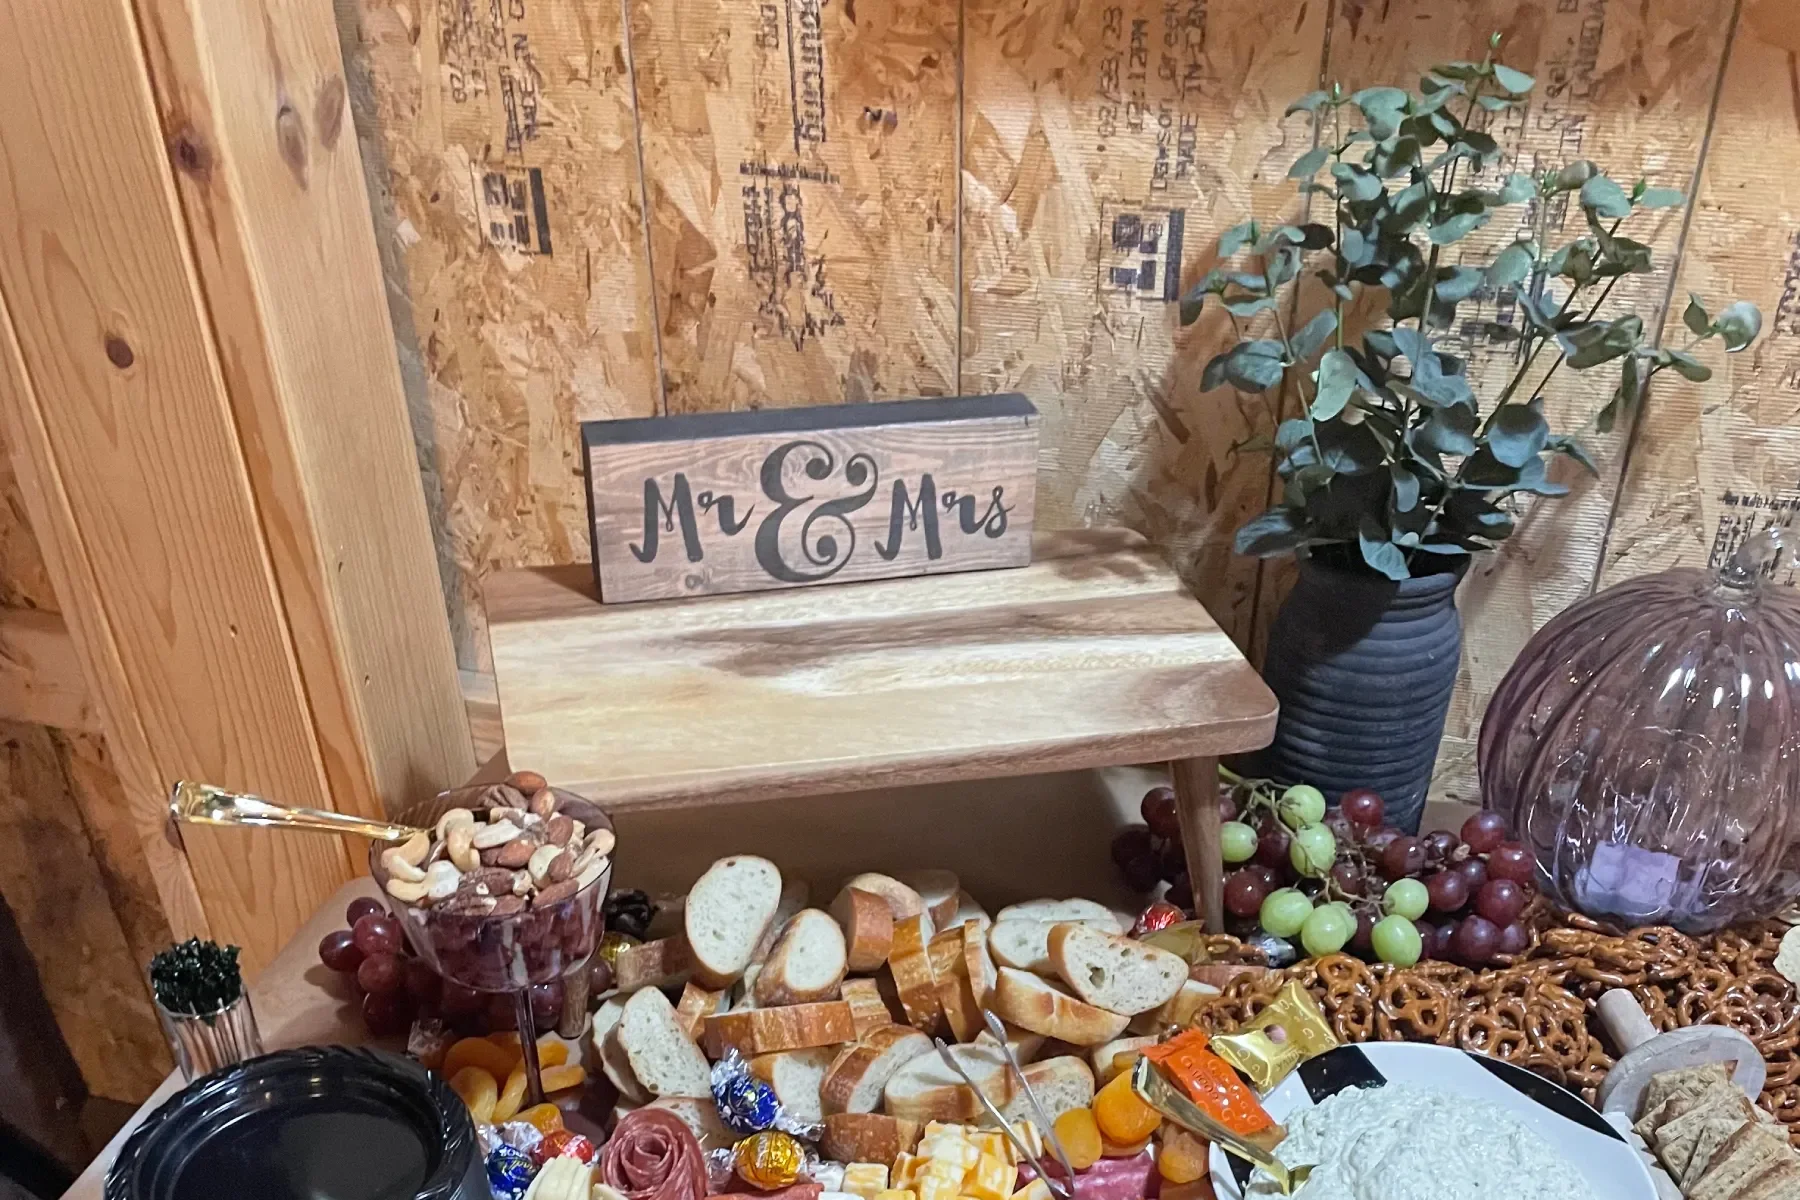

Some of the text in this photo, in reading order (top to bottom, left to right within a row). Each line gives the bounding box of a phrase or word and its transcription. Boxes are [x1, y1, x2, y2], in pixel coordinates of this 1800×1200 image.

[629, 439, 1016, 583] Mr & Mrs
